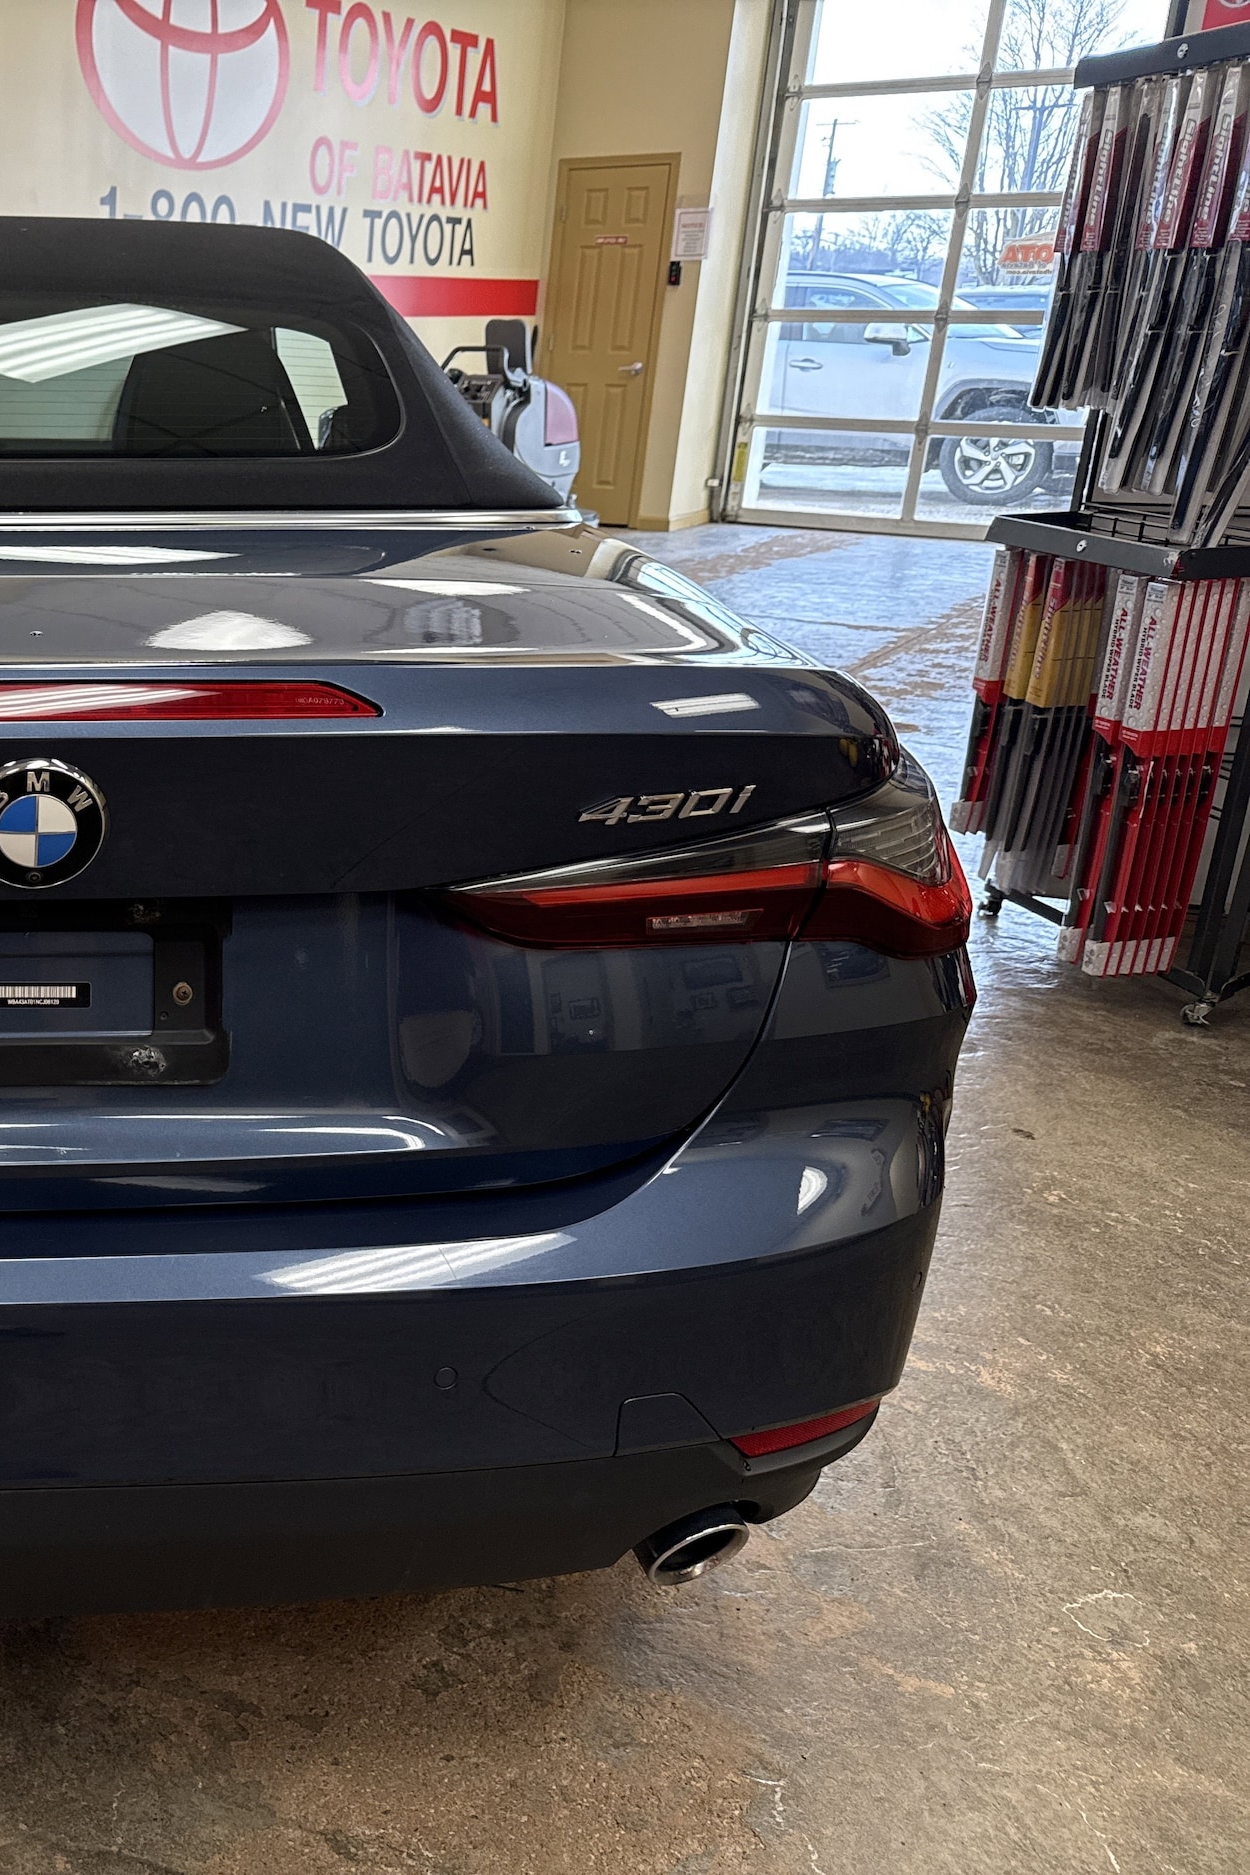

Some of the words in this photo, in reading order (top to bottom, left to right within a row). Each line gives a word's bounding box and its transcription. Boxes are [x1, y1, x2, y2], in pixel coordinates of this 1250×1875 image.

[305, 0, 498, 123] TOYOTA
[309, 135, 358, 197] OF
[371, 145, 488, 210] BATAVIA
[362, 208, 475, 267] TOYOTA
[984, 578, 1002, 663] ALL-WEATHER
[1110, 618, 1120, 648] HYBRID
[1138, 627, 1148, 657] HYBRID
[1105, 648, 1115, 674] WIPER
[1106, 607, 1129, 701] ALL-WEATHER
[1133, 615, 1158, 711] ALL-WEATHER
[1133, 657, 1142, 683] WIPER
[1101, 674, 1110, 700] BLADE
[1128, 683, 1137, 710] BLADE
